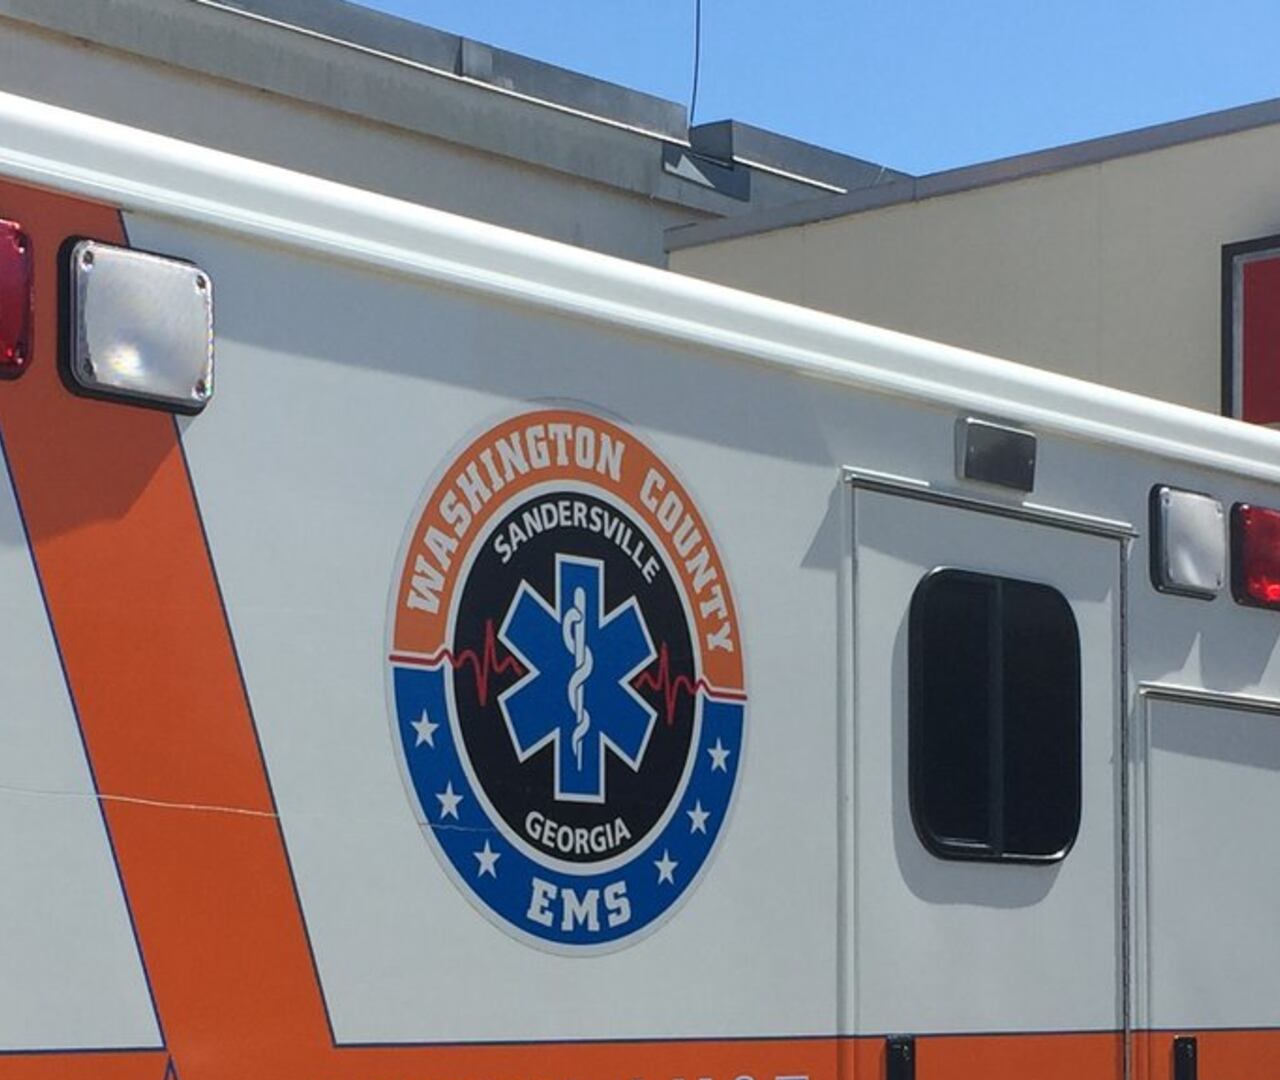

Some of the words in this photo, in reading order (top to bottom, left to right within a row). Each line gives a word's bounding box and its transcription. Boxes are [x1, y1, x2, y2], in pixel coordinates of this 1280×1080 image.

[407, 422, 625, 614] WASHINGTON
[639, 469, 733, 653] COUNTY
[493, 500, 660, 584] SANDERSVILLE
[525, 810, 630, 855] GEORGIA
[527, 876, 630, 932] EMS
